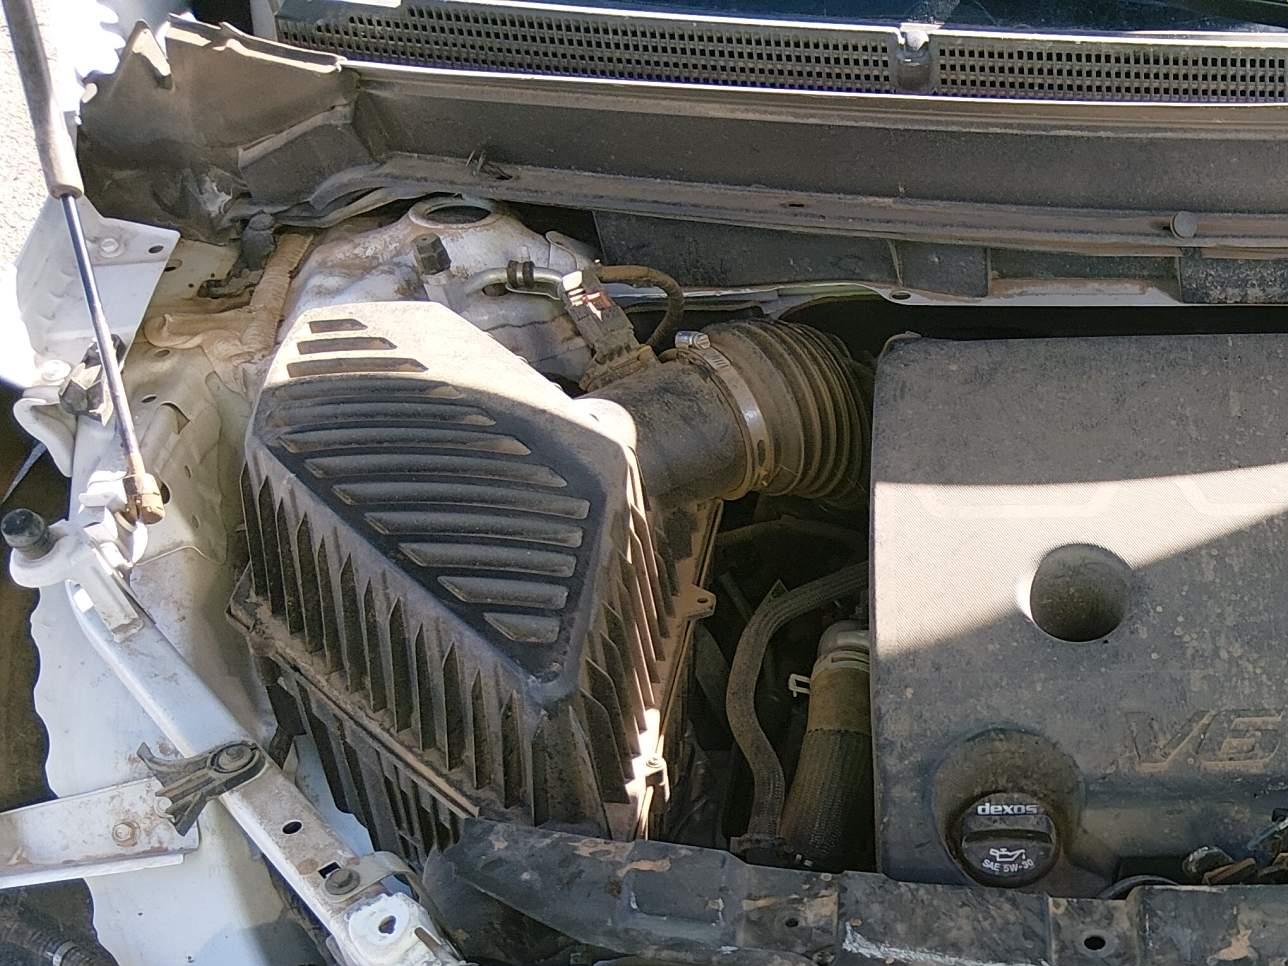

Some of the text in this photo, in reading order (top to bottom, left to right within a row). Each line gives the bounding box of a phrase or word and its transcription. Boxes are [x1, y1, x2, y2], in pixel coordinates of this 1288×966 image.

[1124, 709, 1285, 772] V6
[977, 803, 1039, 815] dexos
[982, 859, 1034, 873] SAE 5W-30
